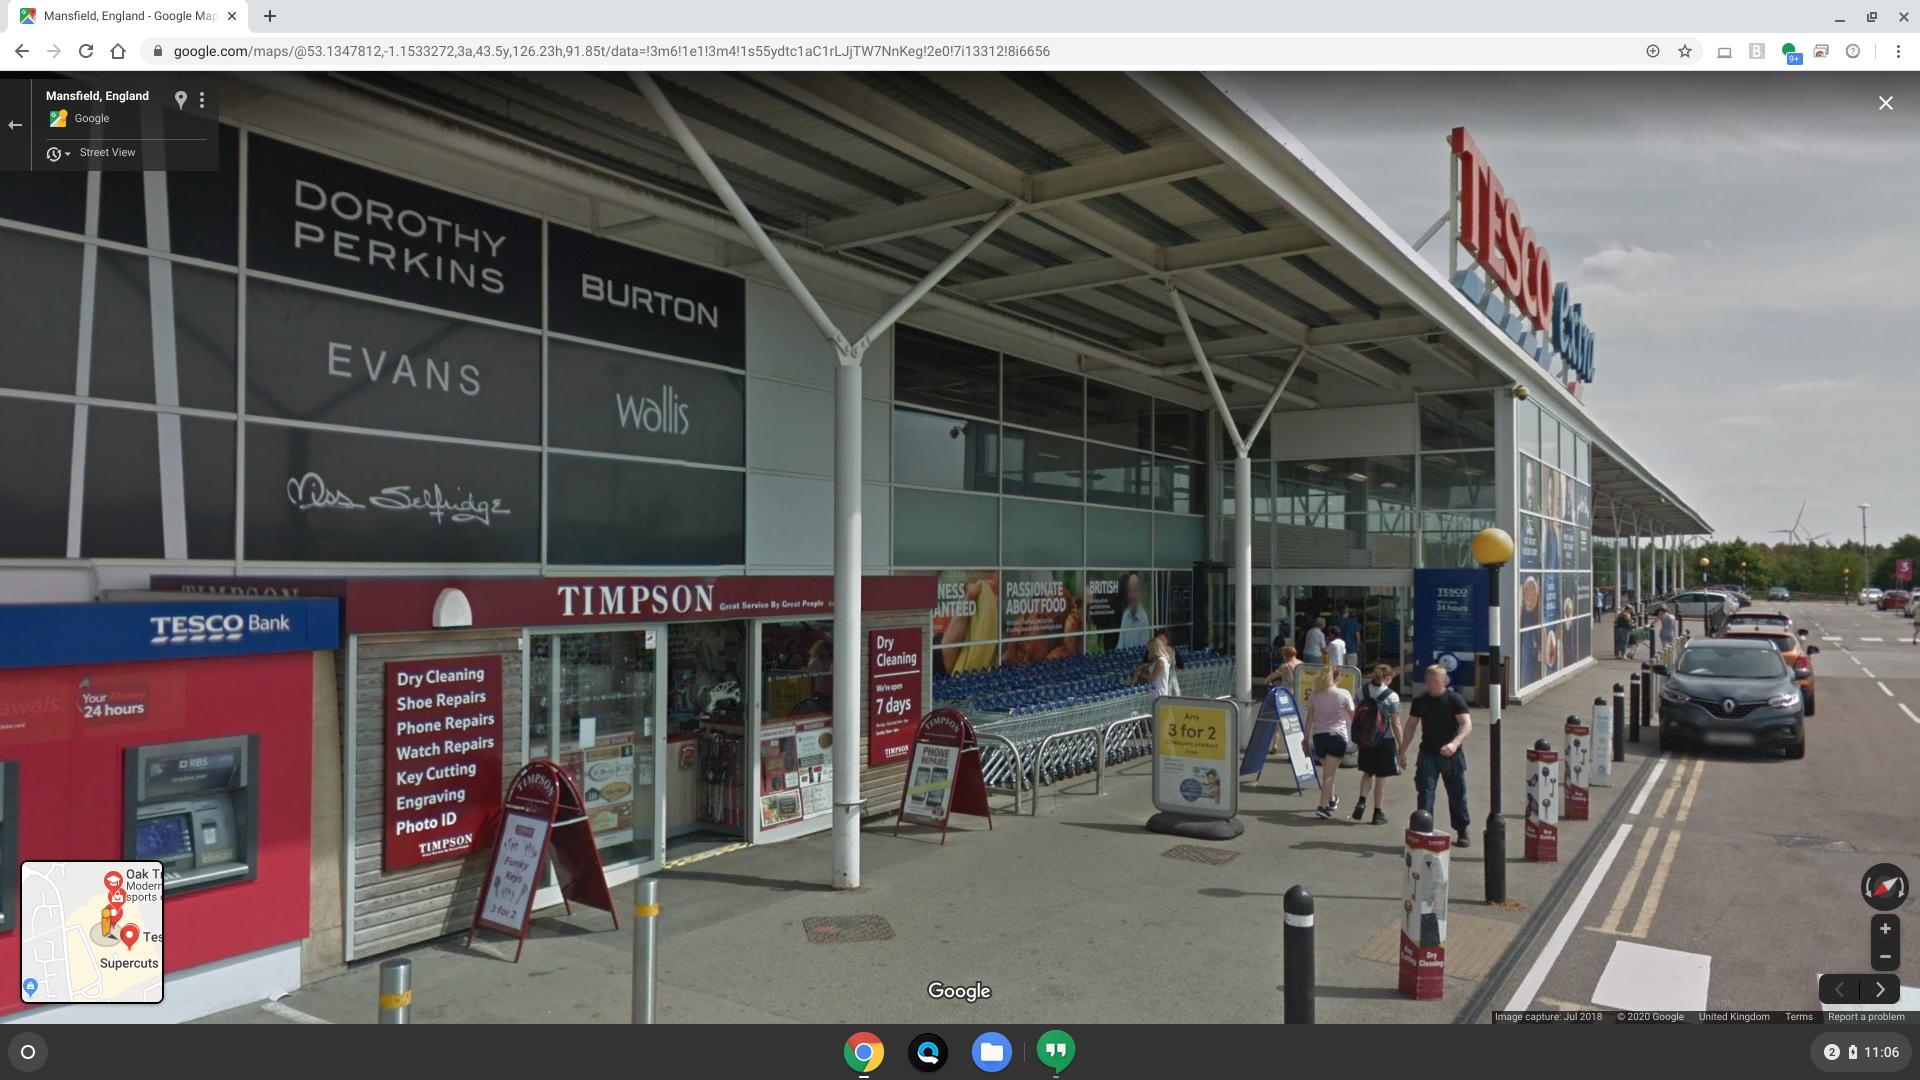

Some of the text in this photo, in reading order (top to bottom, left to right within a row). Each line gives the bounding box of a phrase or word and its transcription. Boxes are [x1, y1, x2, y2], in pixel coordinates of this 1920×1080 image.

[295, 179, 506, 258] DOROTHY
[1452, 127, 1552, 331] TESCO
[295, 221, 505, 294] PERKINS
[582, 273, 718, 329] BURTON
[328, 341, 481, 396] EVANS
[370, 482, 511, 525] Selfridge
[1901, 562, 1909, 572] 3
[938, 582, 966, 599] NESS
[1006, 581, 1063, 598] PASSIONATE
[1089, 580, 1119, 594] BRITISH
[1437, 587, 1468, 595] TESCO
[557, 584, 716, 617] TIMPSON
[720, 602, 740, 611] Great
[742, 601, 769, 609] Service
[770, 600, 780, 609] By
[782, 600, 801, 608] Great
[802, 600, 824, 609] People
[933, 600, 977, 617] ANTEED
[1005, 597, 1066, 615] ABOUT FOOD
[1447, 604, 1468, 612] hours
[150, 613, 291, 635] TESCO Bank
[877, 636, 894, 651] Dry
[876, 651, 917, 667] Cleaning
[397, 669, 485, 688] Dry Cleaning
[82, 693, 108, 704] Your
[397, 691, 487, 711] Shoe Repairs
[876, 696, 912, 715] 7 days
[84, 703, 145, 719] 24 hours
[1184, 713, 1200, 721] Any
[397, 713, 495, 736] Phone Repairs
[925, 716, 961, 733] TIMPSON
[1168, 724, 1217, 740] 3 for 2
[396, 737, 495, 761] Watch Repairs
[885, 744, 909, 756] TIMPSON
[923, 746, 951, 759] PHONE
[396, 763, 477, 786] Key Cutting
[517, 773, 555, 797] TIMPSON
[396, 788, 466, 811] Engraving
[396, 812, 457, 836] Photo ID
[419, 833, 473, 853] TIMPSON
[504, 856, 530, 872] Funky
[505, 871, 523, 884] Keys
[489, 903, 517, 920] 3 for 2
[1418, 960, 1444, 968] Cleaning
[1426, 951, 1438, 960] Dry
